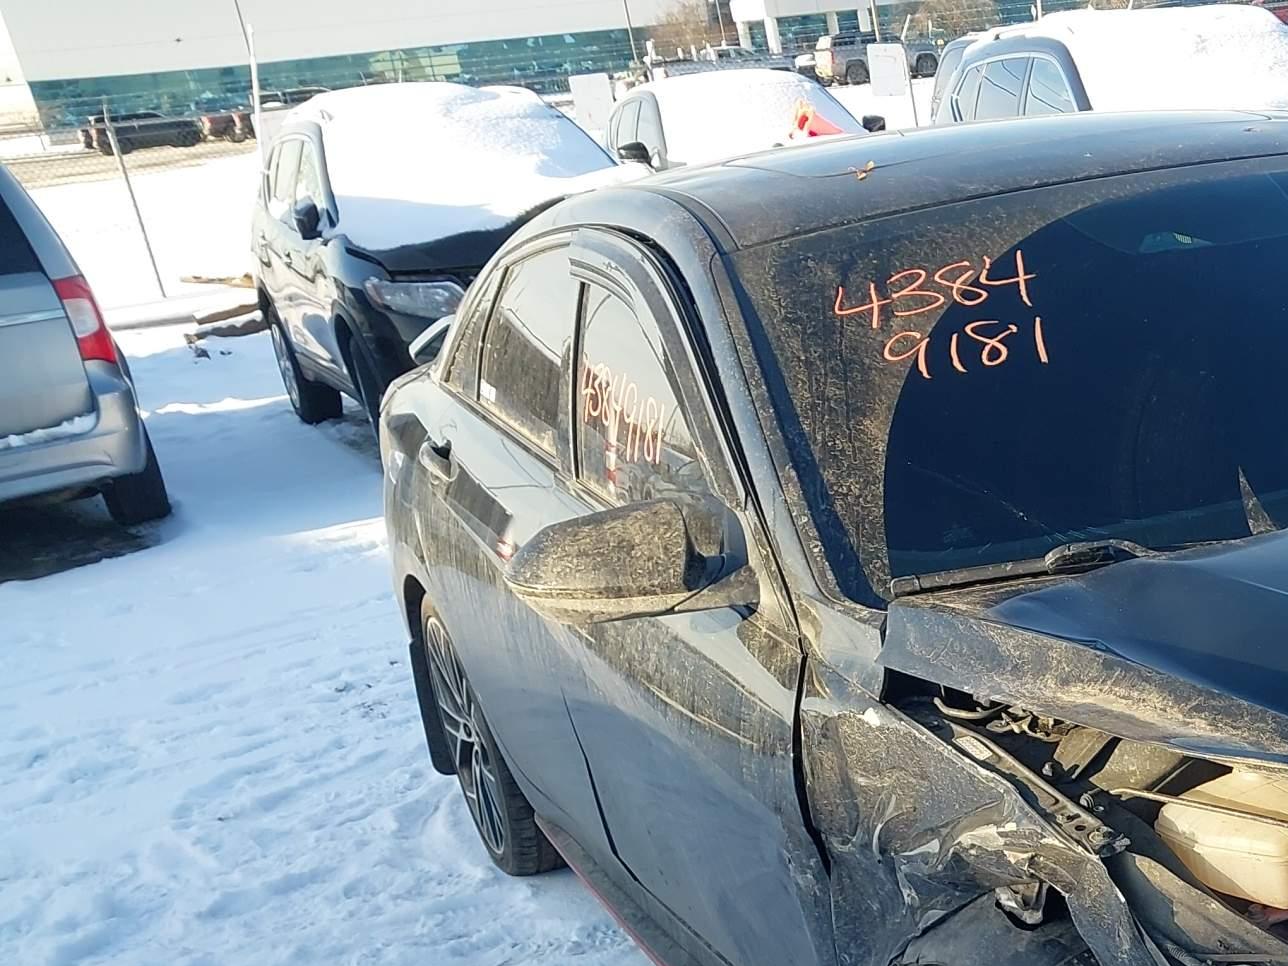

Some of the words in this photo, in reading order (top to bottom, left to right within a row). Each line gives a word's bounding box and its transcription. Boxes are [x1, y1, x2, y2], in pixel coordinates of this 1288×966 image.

[834, 248, 1037, 329] 4384
[883, 317, 1049, 379] 9181
[582, 354, 664, 464] 43849181
